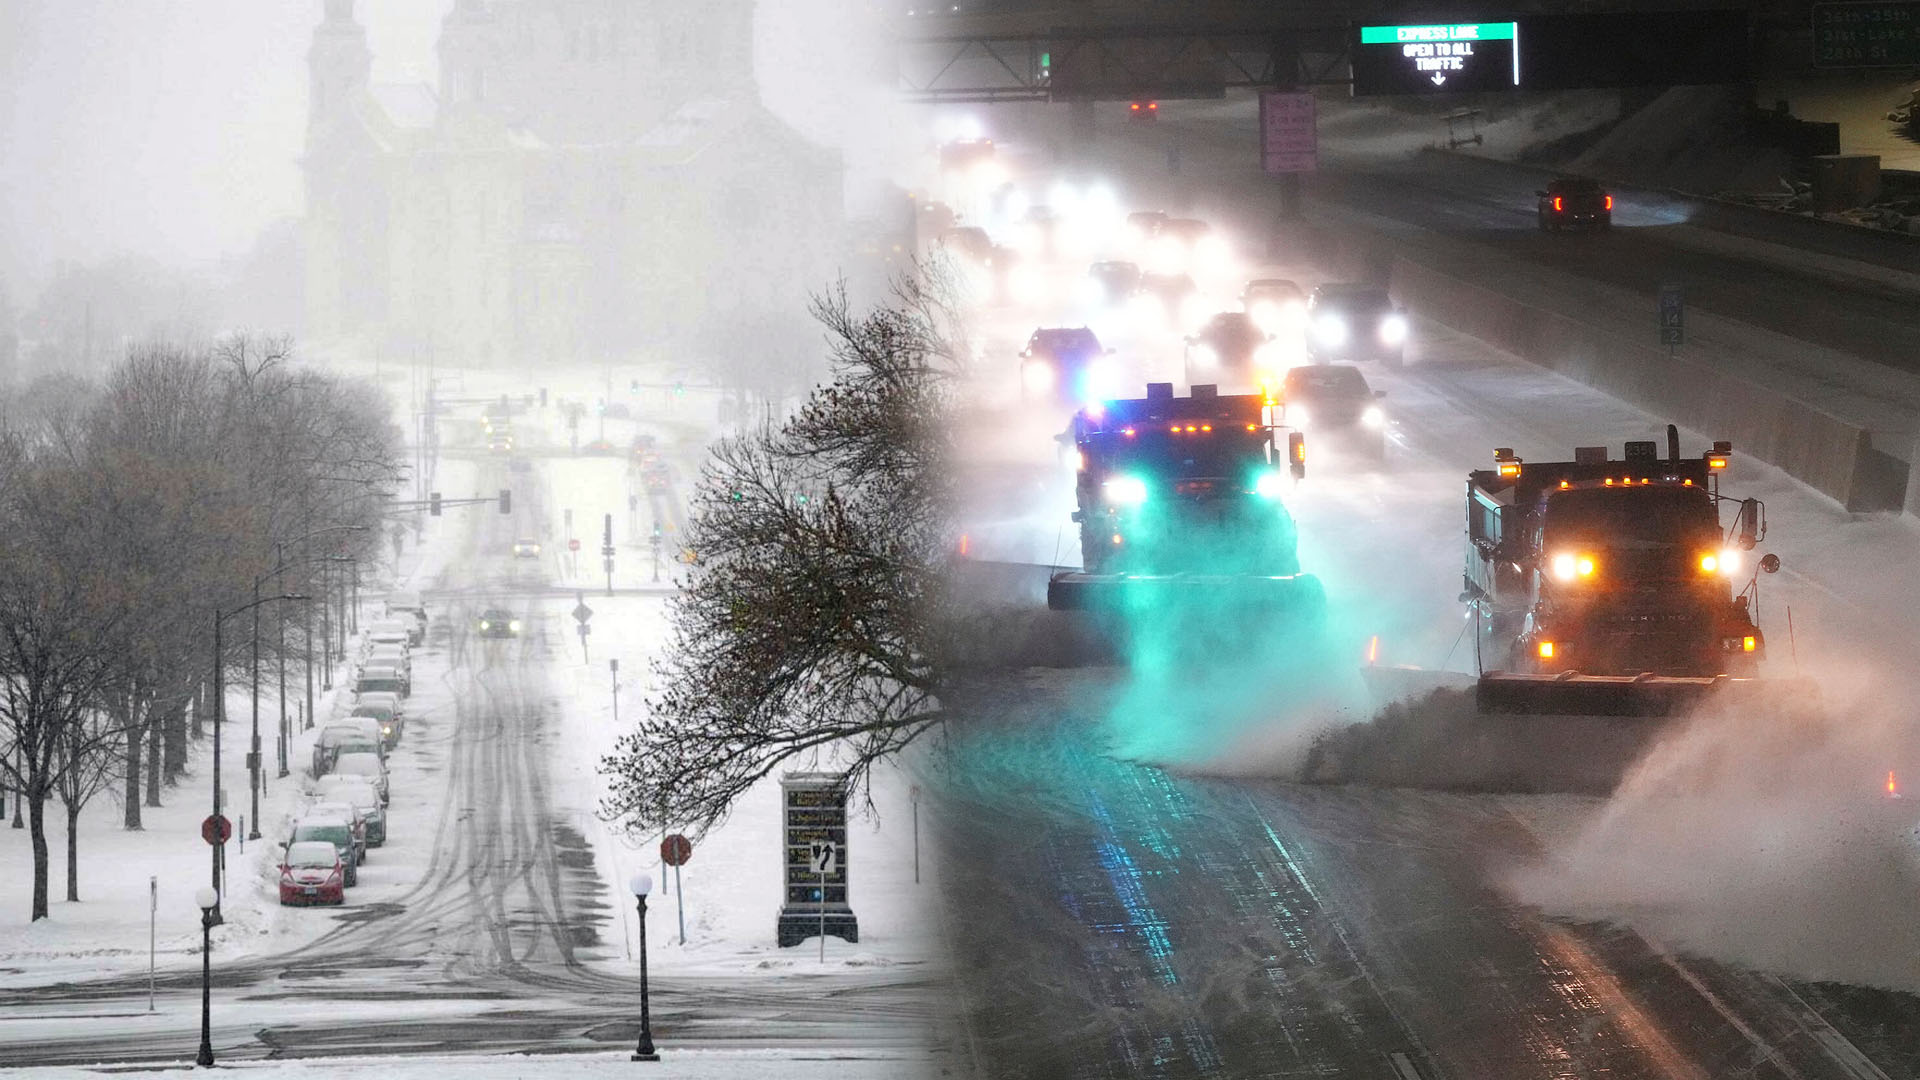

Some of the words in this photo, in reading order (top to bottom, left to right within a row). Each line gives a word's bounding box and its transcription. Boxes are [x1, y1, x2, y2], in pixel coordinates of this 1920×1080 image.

[1397, 27, 1448, 41] EXPRESS
[1450, 26, 1479, 39] LANE
[1403, 43, 1434, 57] OPEN
[1435, 43, 1451, 56] TO
[1452, 42, 1474, 56] ALL
[1415, 57, 1464, 71] TRAFFIC
